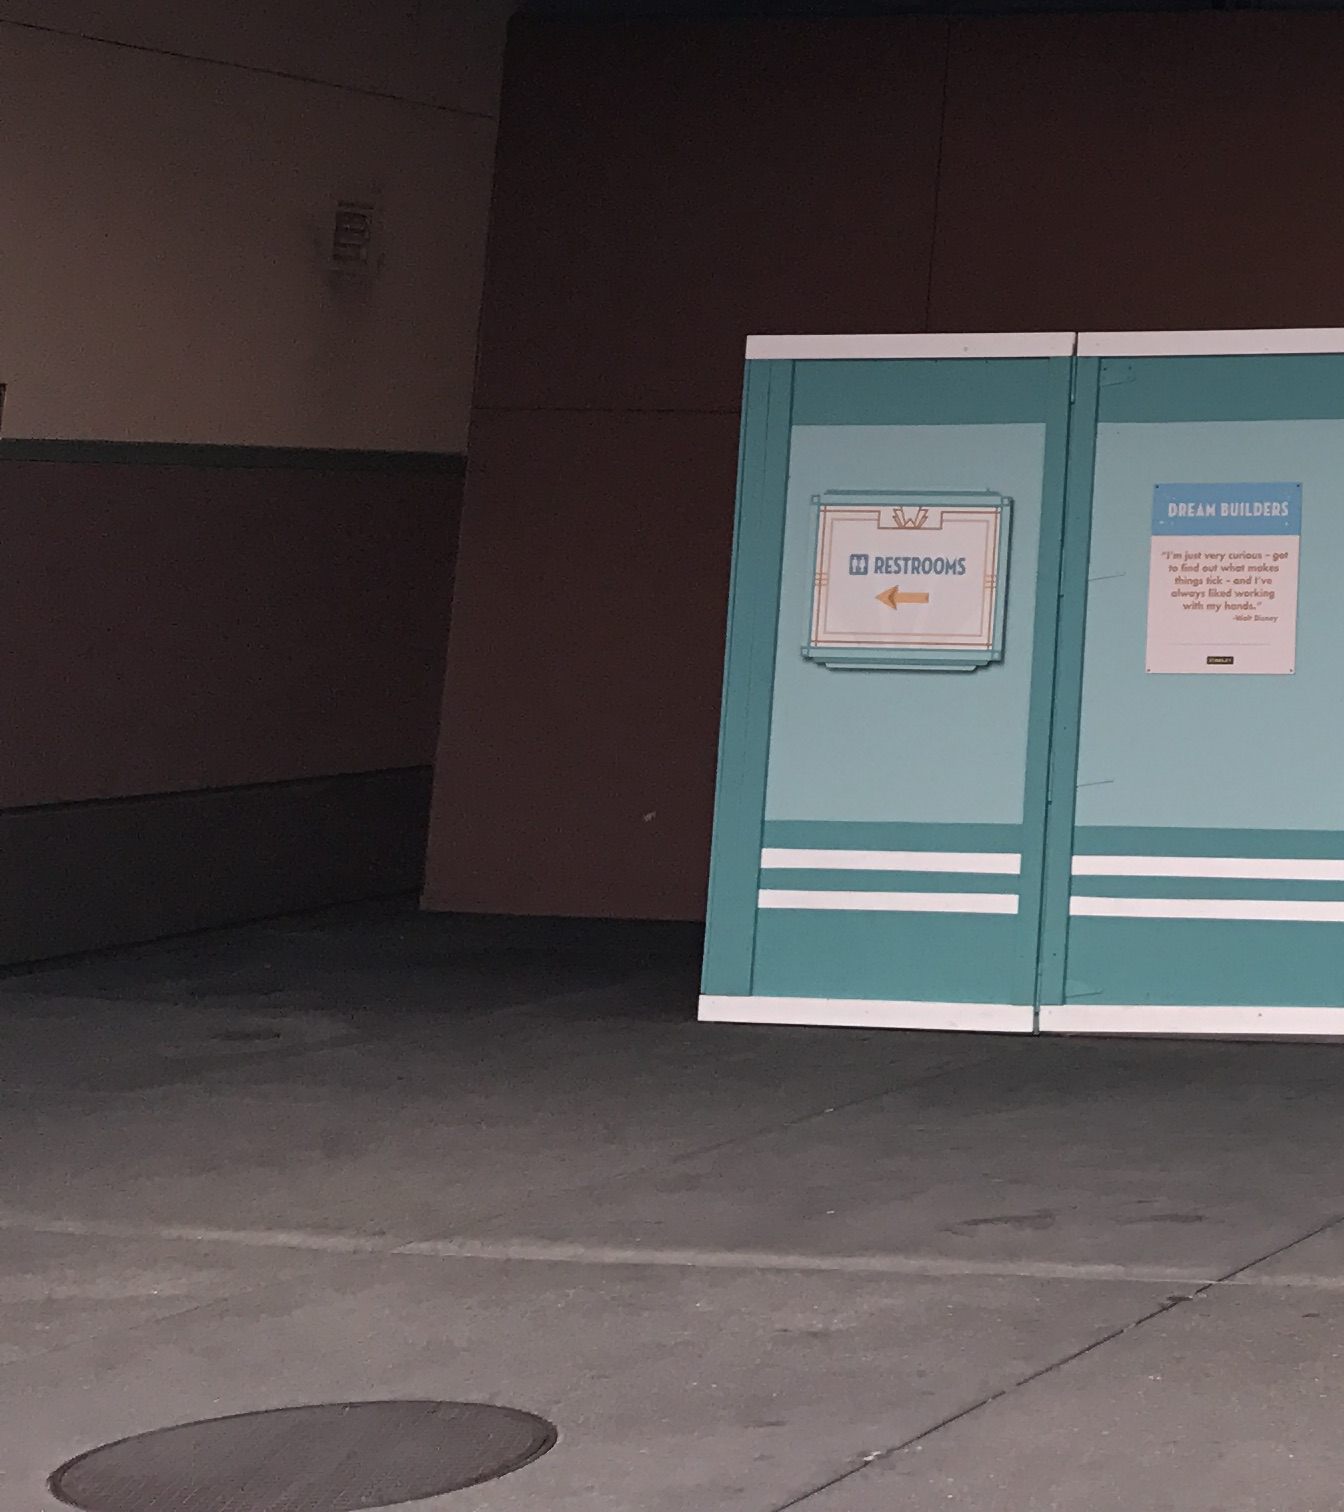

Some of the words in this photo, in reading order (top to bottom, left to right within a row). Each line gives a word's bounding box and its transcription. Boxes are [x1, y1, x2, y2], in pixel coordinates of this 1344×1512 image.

[1168, 503, 1216, 517] DREAM
[1221, 501, 1289, 516] BUILDERS
[1184, 550, 1202, 562] just
[1204, 552, 1225, 562] very
[1228, 550, 1262, 560] curious
[1272, 552, 1289, 562] got
[873, 556, 967, 576] RESTROOMS
[1181, 563, 1199, 572] find
[1220, 563, 1245, 572] what
[1247, 563, 1279, 572] makes
[1174, 576, 1203, 587] things
[1206, 576, 1223, 584] tick
[1233, 576, 1251, 584] and
[1171, 589, 1205, 599] always
[1208, 588, 1232, 597] liked
[1234, 588, 1275, 600] working
[1182, 601, 1203, 610] with
[1206, 603, 1221, 612] my
[1254, 615, 1278, 623] Disney
